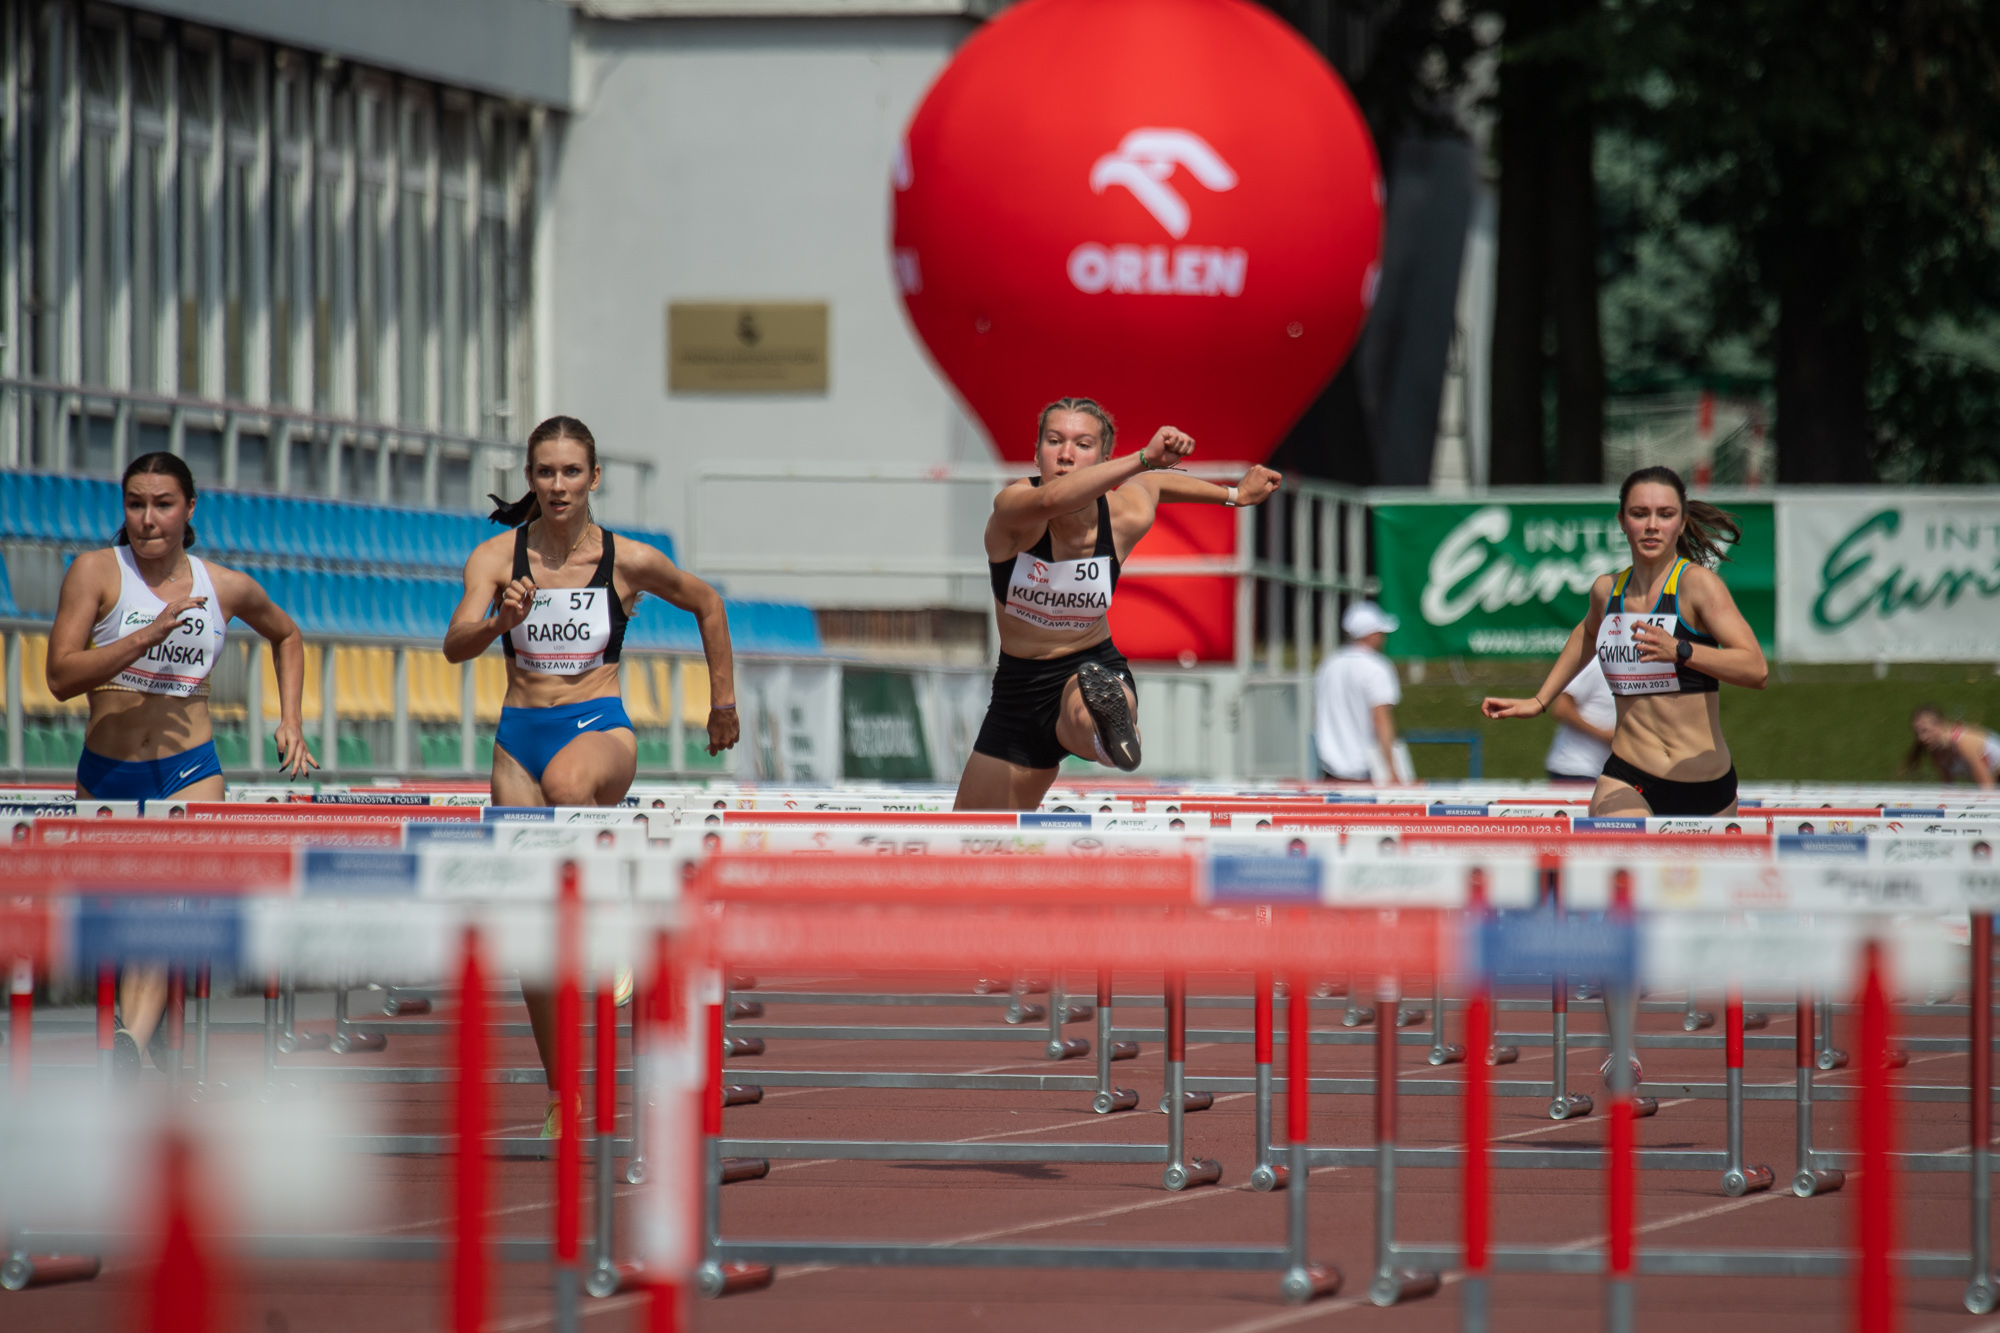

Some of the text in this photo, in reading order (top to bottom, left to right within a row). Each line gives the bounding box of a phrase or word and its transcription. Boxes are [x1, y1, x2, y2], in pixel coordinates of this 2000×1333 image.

[1067, 241, 1248, 297] ORLEN
[1523, 519, 1629, 552] INTE
[1074, 561, 1099, 581] 50
[1420, 506, 1632, 627] Euro
[1027, 573, 1049, 584] ORLEN
[569, 592, 595, 610] 57
[1012, 585, 1108, 609] KUCHARSKA
[125, 611, 155, 625] Euro
[182, 617, 204, 636] 59
[1015, 608, 1071, 628] WARSZAWA
[527, 618, 590, 642] RARÓG
[141, 641, 204, 666] LIŃSKA
[523, 658, 576, 670] WARSZAWA
[121, 673, 174, 691] WARSZAWA
[1649, 680, 1670, 689] 2023
[339, 796, 392, 804] MISTRZOSTWA
[35, 807, 74, 818] 2021
[195, 813, 222, 821] PZLA
[345, 815, 415, 823] WIELOBOJACH
[504, 813, 545, 821] WARSZAWA
[1282, 825, 1309, 833] PZLA
[1313, 825, 1384, 834] MISTRZOSTWA
[1386, 826, 1420, 834] POLSKI
[1422, 826, 1432, 834] W
[1434, 825, 1505, 834] WIELOBOJACH
[1555, 826, 1561, 834] S
